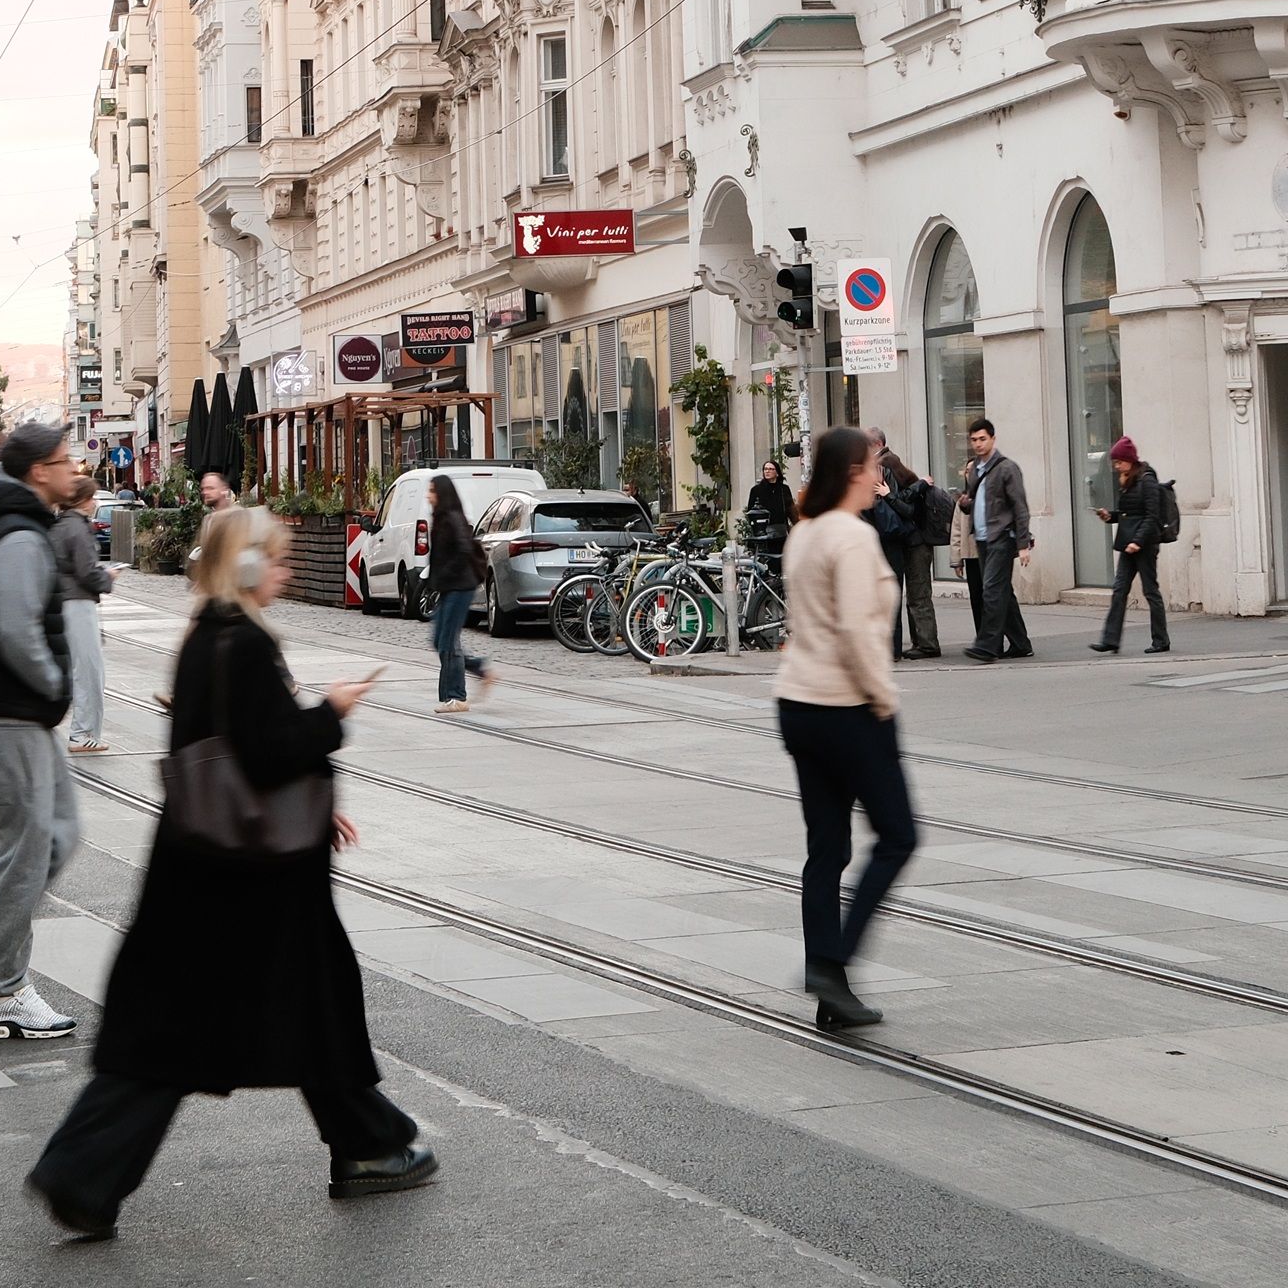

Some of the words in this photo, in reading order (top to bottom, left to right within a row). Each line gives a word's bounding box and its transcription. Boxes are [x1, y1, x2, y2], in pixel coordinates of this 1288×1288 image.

[546, 225, 576, 238] Vini
[577, 228, 599, 240] per
[602, 225, 629, 236] tutti
[407, 316, 430, 325] DEVILS
[451, 314, 470, 322] HAND
[844, 317, 891, 326] Kurzparkzone
[407, 325, 472, 342] TATTOO
[412, 347, 445, 355] KECKEIS
[342, 353, 377, 364] Nguyen's
